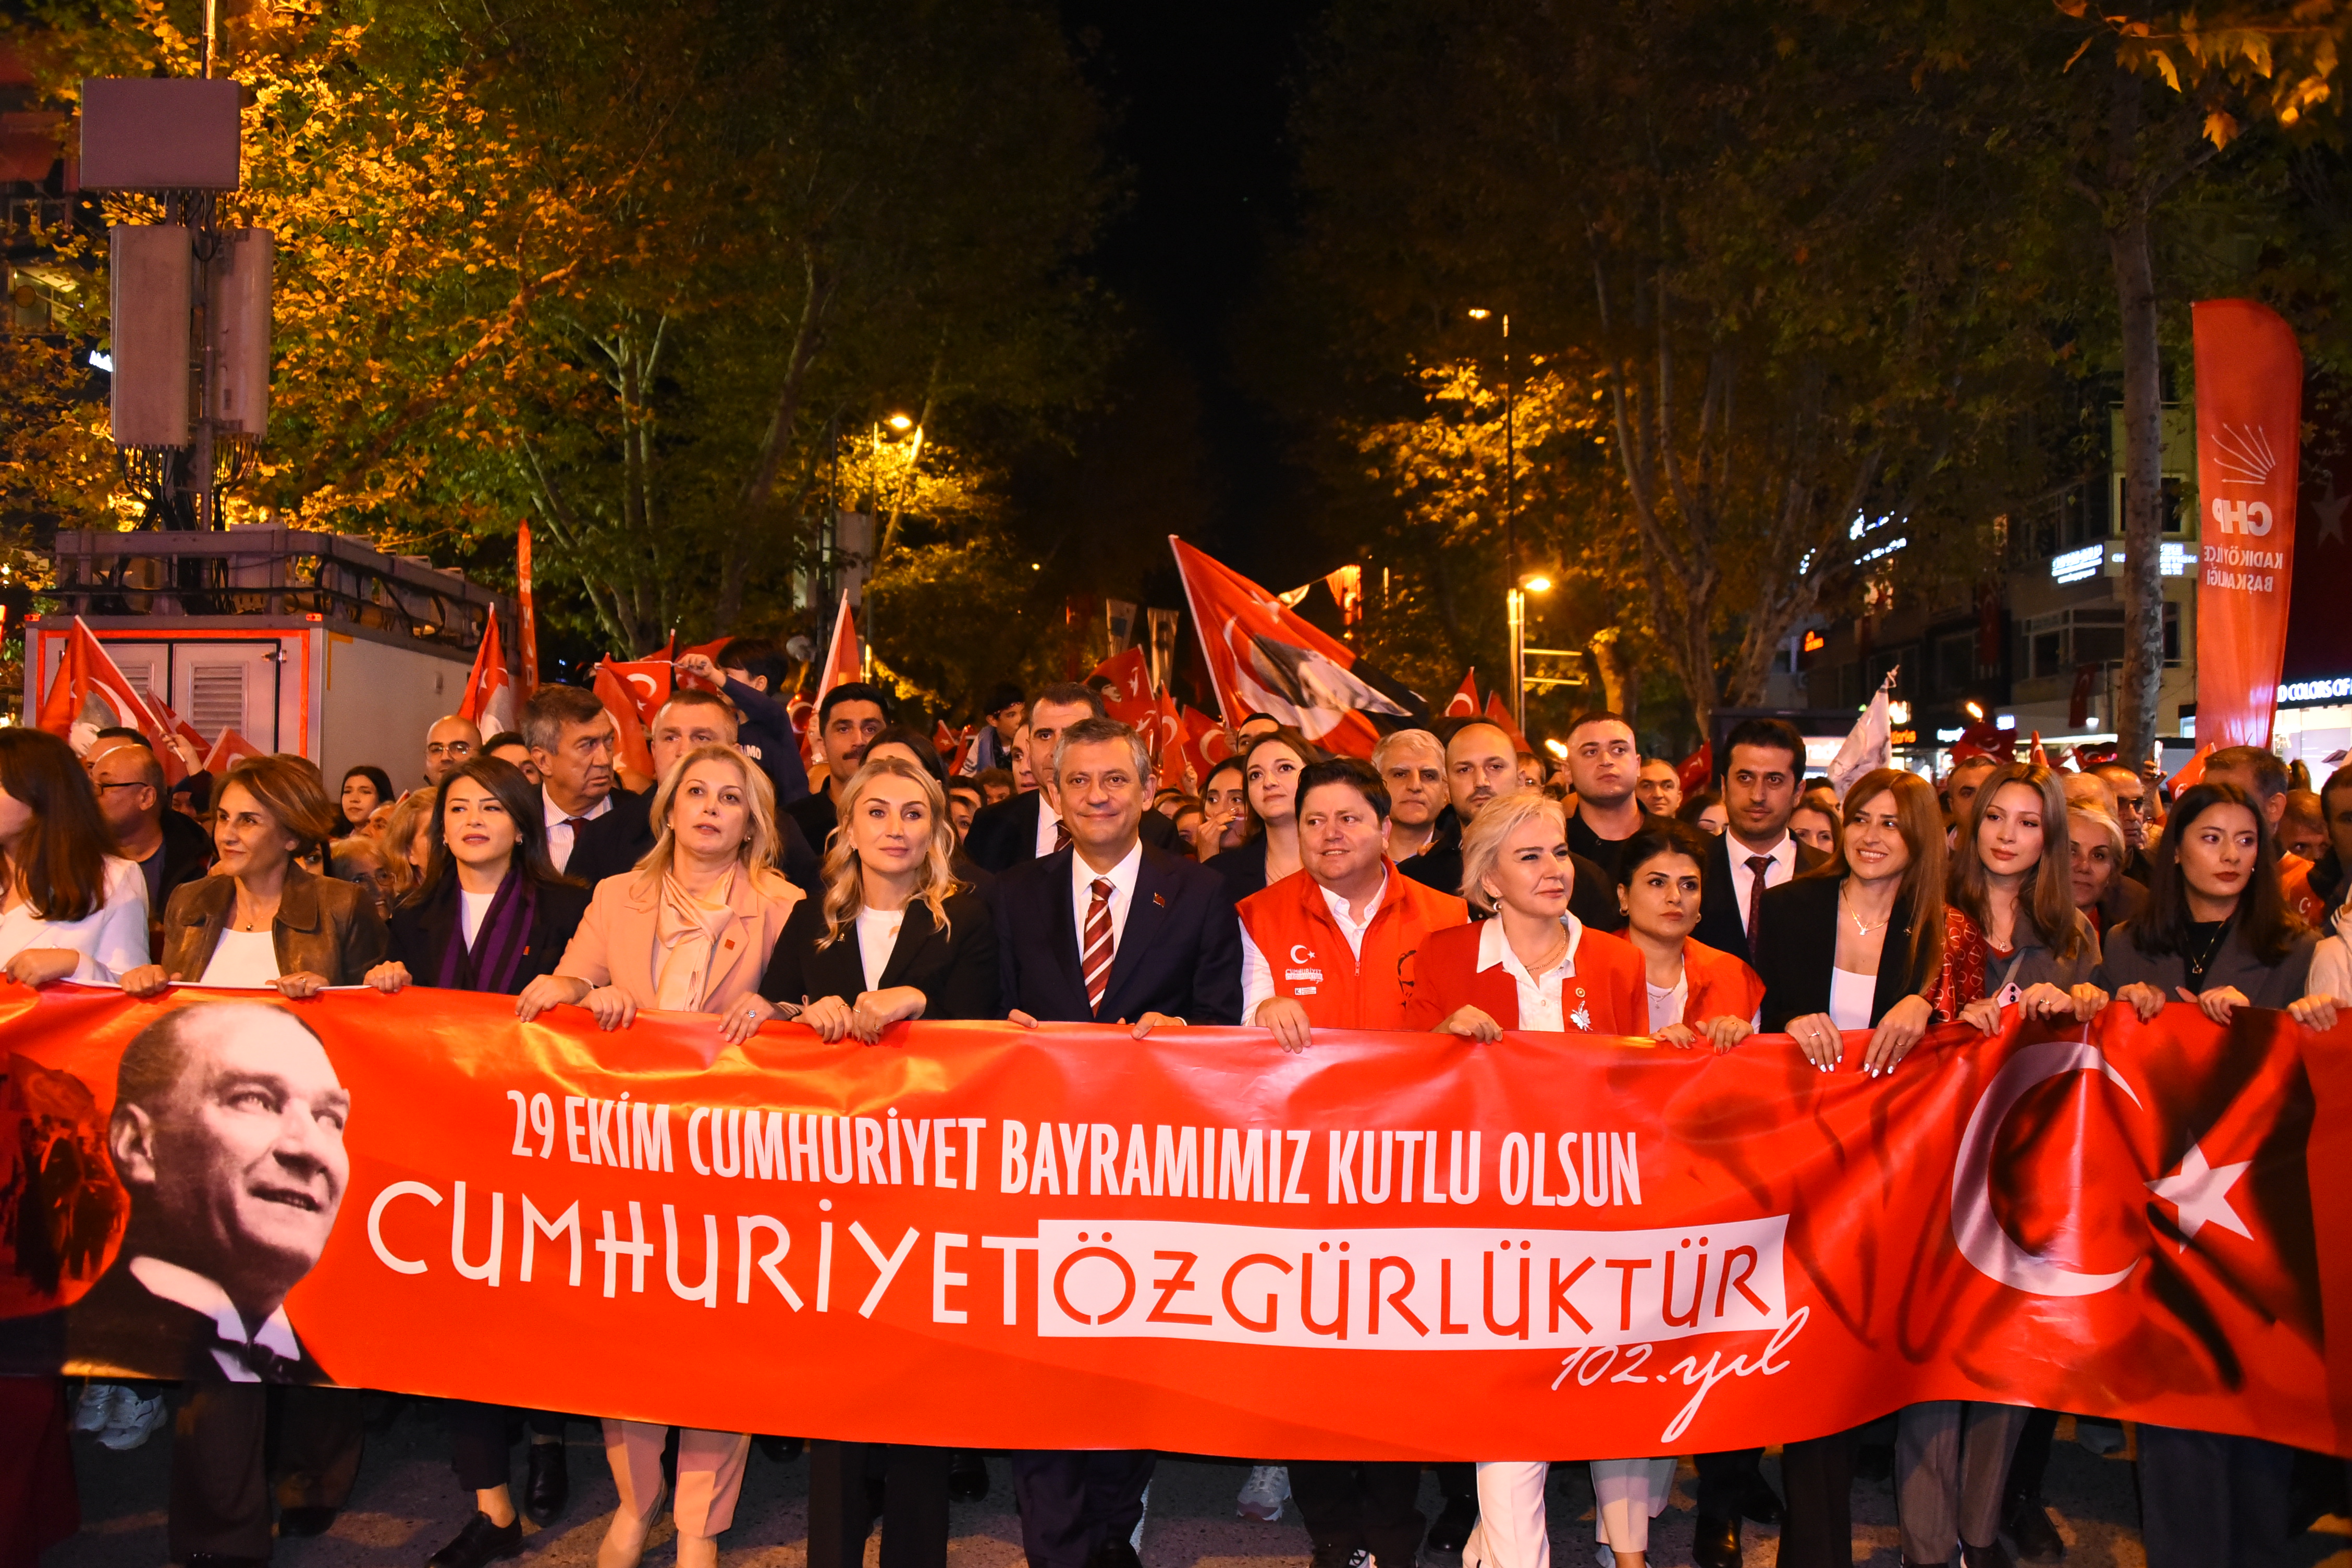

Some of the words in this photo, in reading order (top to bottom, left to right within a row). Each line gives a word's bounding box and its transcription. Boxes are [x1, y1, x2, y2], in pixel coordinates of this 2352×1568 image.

[2333, 678, 2350, 696] OF
[507, 1090, 554, 1159] 29
[565, 1092, 673, 1173] EKİM
[688, 1106, 986, 1191] CUMHURİYET
[1001, 1120, 1310, 1204] BAYRAMIMIZ
[1328, 1130, 1481, 1204] KUTLU
[1500, 1132, 1642, 1207] OLSUN
[368, 1181, 1040, 1326] CUMHURİYET
[1054, 1232, 1770, 1340] ÖZGÜRLÜKTÜR
